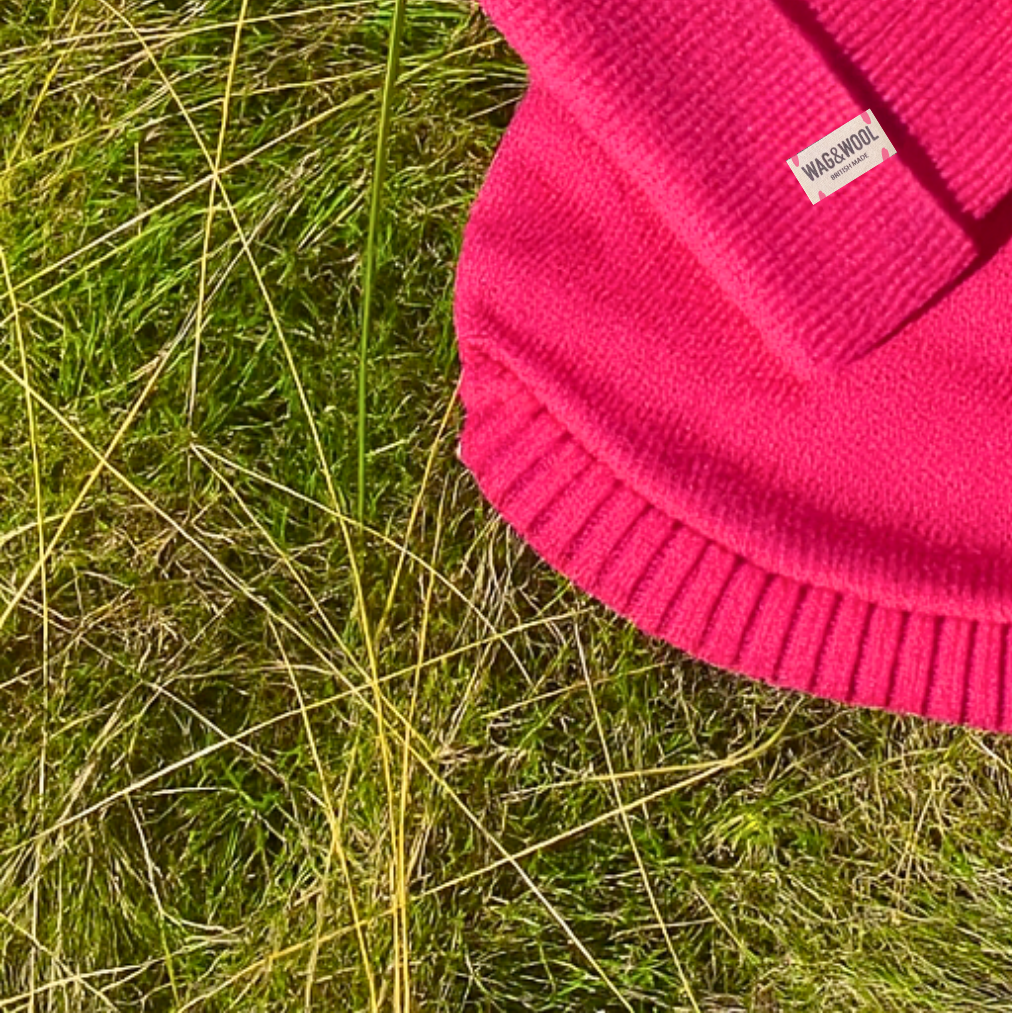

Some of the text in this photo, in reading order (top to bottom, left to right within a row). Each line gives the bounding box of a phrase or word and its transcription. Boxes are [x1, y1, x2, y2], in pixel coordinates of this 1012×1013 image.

[801, 126, 879, 181] WAG&WOOL
[830, 153, 869, 180] BRITISH MADE
